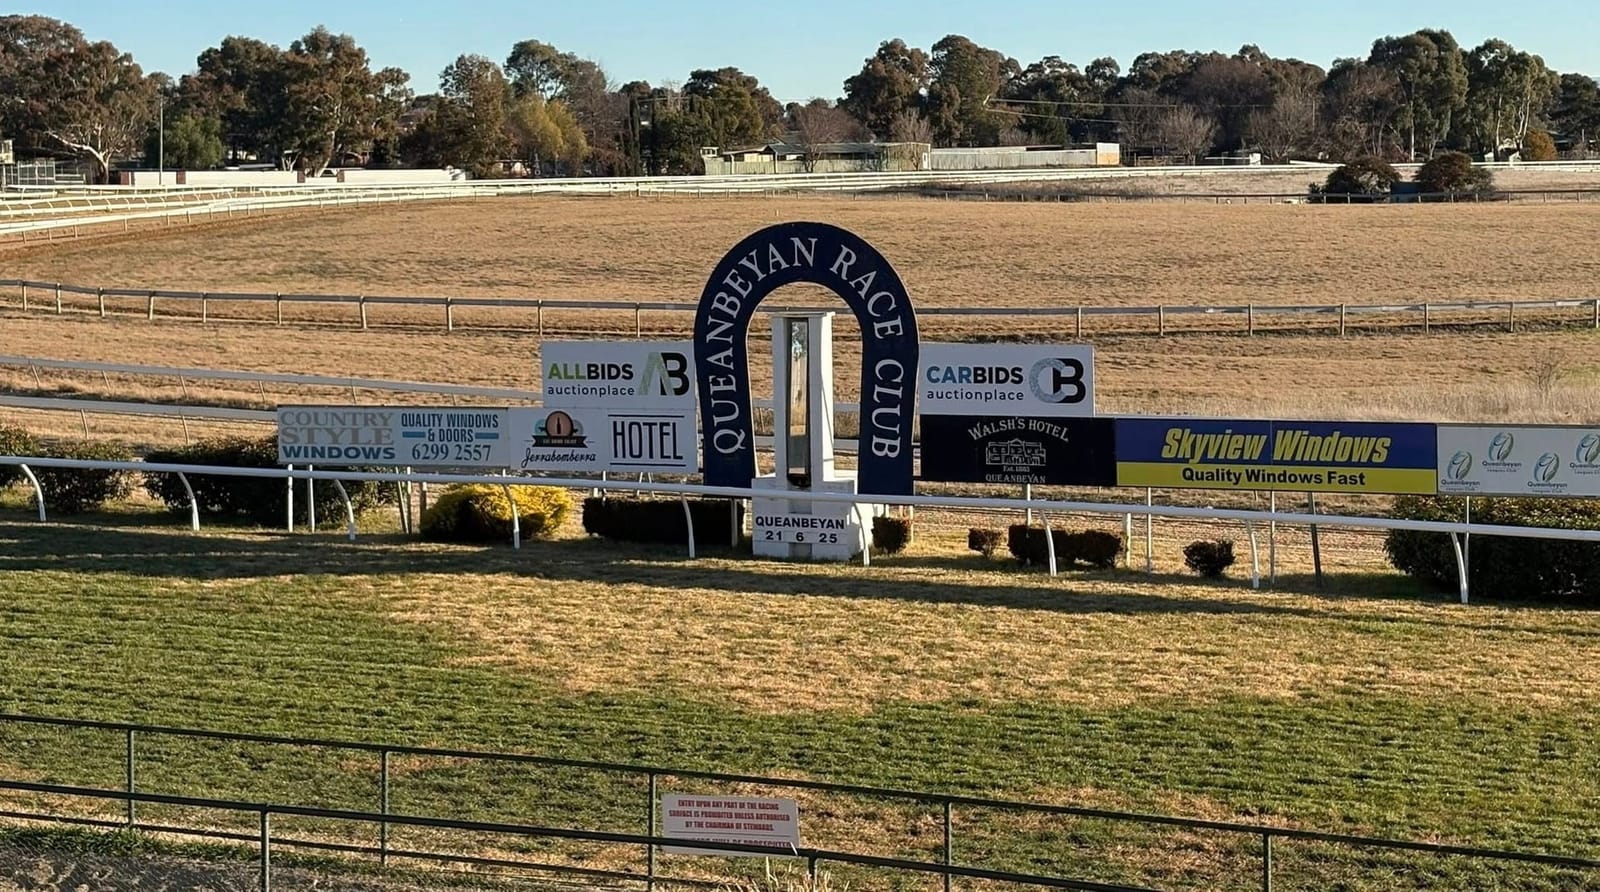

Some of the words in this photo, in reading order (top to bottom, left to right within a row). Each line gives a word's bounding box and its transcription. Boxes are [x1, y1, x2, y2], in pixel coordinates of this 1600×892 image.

[706, 237, 818, 454] QUEANBEYAN
[829, 244, 904, 339] RACE
[871, 359, 904, 459] CLUB
[548, 363, 634, 380] ALLBIDS
[926, 366, 1024, 384] CARBIDS
[547, 384, 635, 397] auctionplace
[927, 388, 1024, 402] auctionplace
[281, 411, 395, 426] COUNTRY
[401, 413, 443, 427] QUALITY
[446, 413, 499, 428] WINDOWS
[281, 427, 394, 445] STYLE
[428, 428, 435, 441] &
[439, 429, 474, 442] DOORS
[968, 416, 1026, 440] WALSH'S
[1028, 419, 1069, 442] HOTEL
[613, 421, 683, 460] HOTEL
[1161, 428, 1267, 464] Skyview
[1273, 430, 1391, 463] Windows
[282, 446, 396, 459] WINDOWS
[412, 443, 449, 460] 6299
[454, 444, 491, 461] 2557
[521, 447, 597, 468] Jerrabomberra
[1569, 462, 1600, 470] Queanbe
[985, 473, 1046, 483] QUEANBEYAN
[1182, 467, 1242, 485] Quality
[1245, 469, 1323, 484] Windows
[1327, 471, 1366, 485] Fast
[755, 516, 844, 529] QUEANBEYAN
[765, 530, 782, 541] 21
[796, 532, 804, 541] 6
[818, 533, 838, 543] 25
[712, 800, 722, 808] ANY
